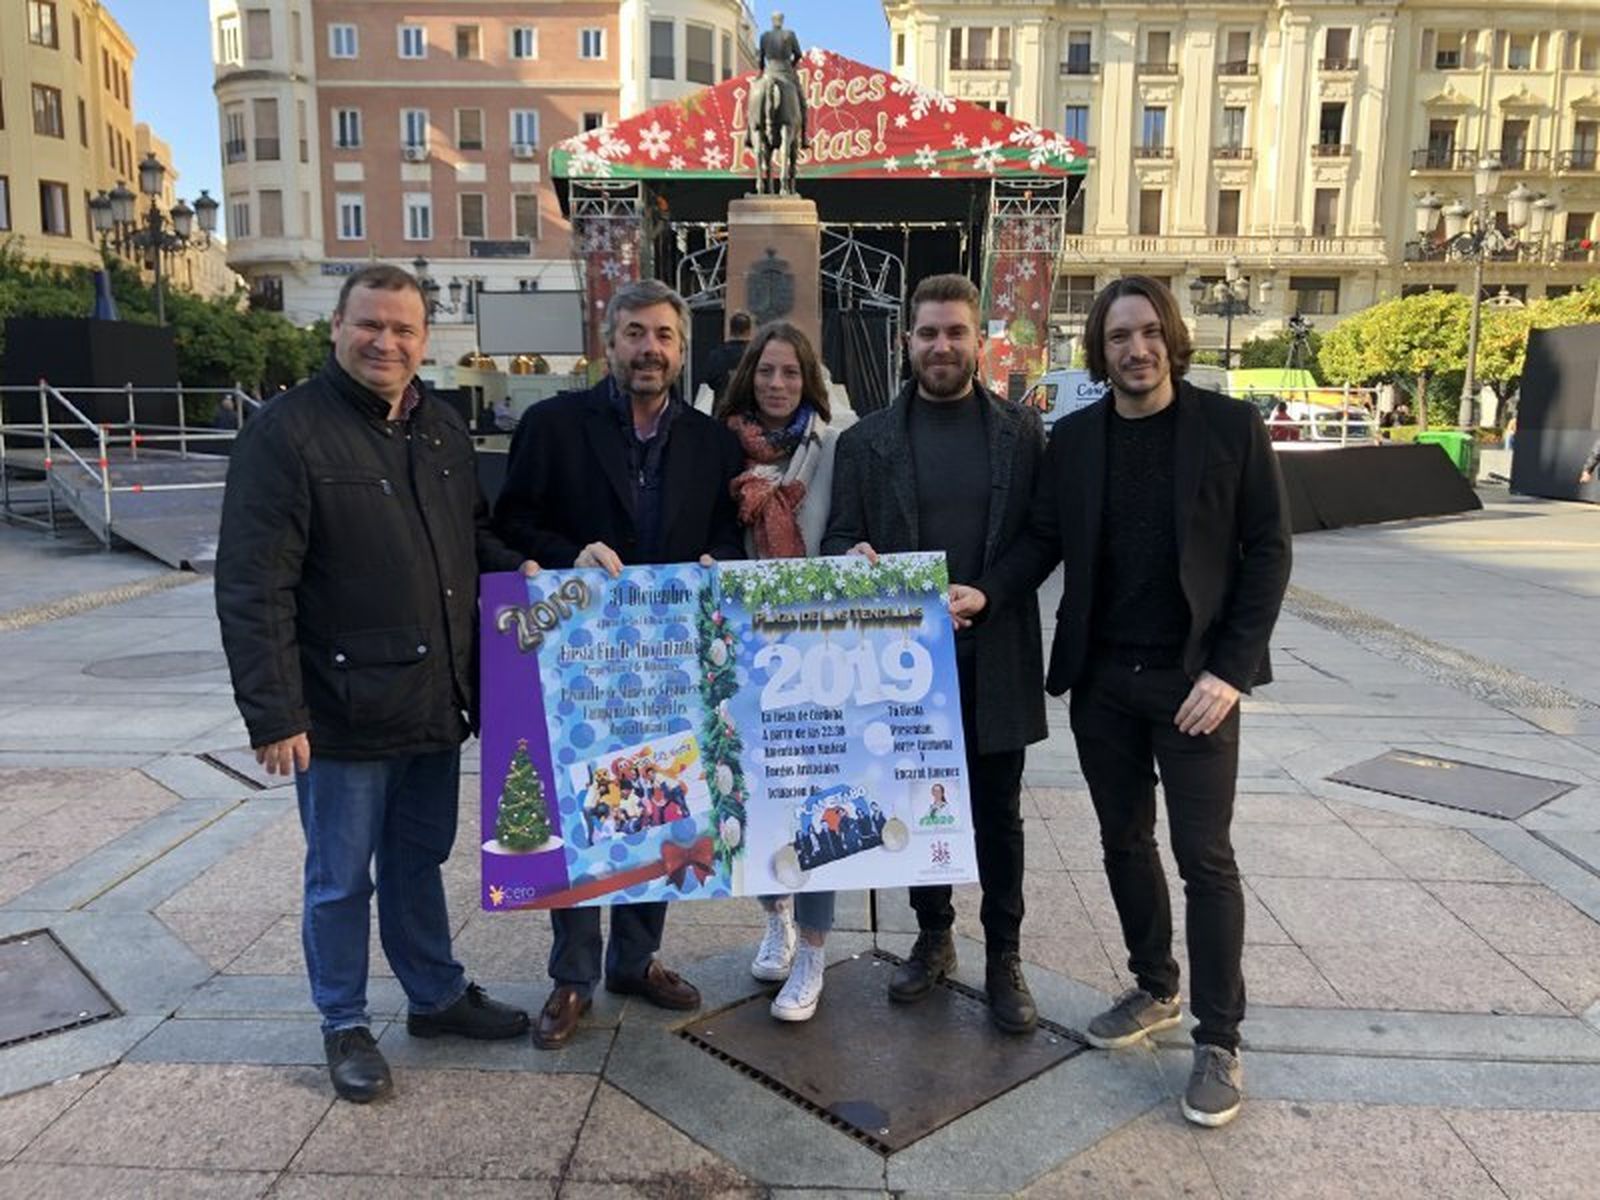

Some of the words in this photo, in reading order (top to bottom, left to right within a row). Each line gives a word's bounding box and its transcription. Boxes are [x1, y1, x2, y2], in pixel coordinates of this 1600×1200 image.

[732, 69, 887, 130] ¡lices
[729, 111, 888, 174] Fstas!
[497, 577, 592, 652] 2019
[800, 610, 819, 629] DE
[753, 638, 933, 712] 2019
